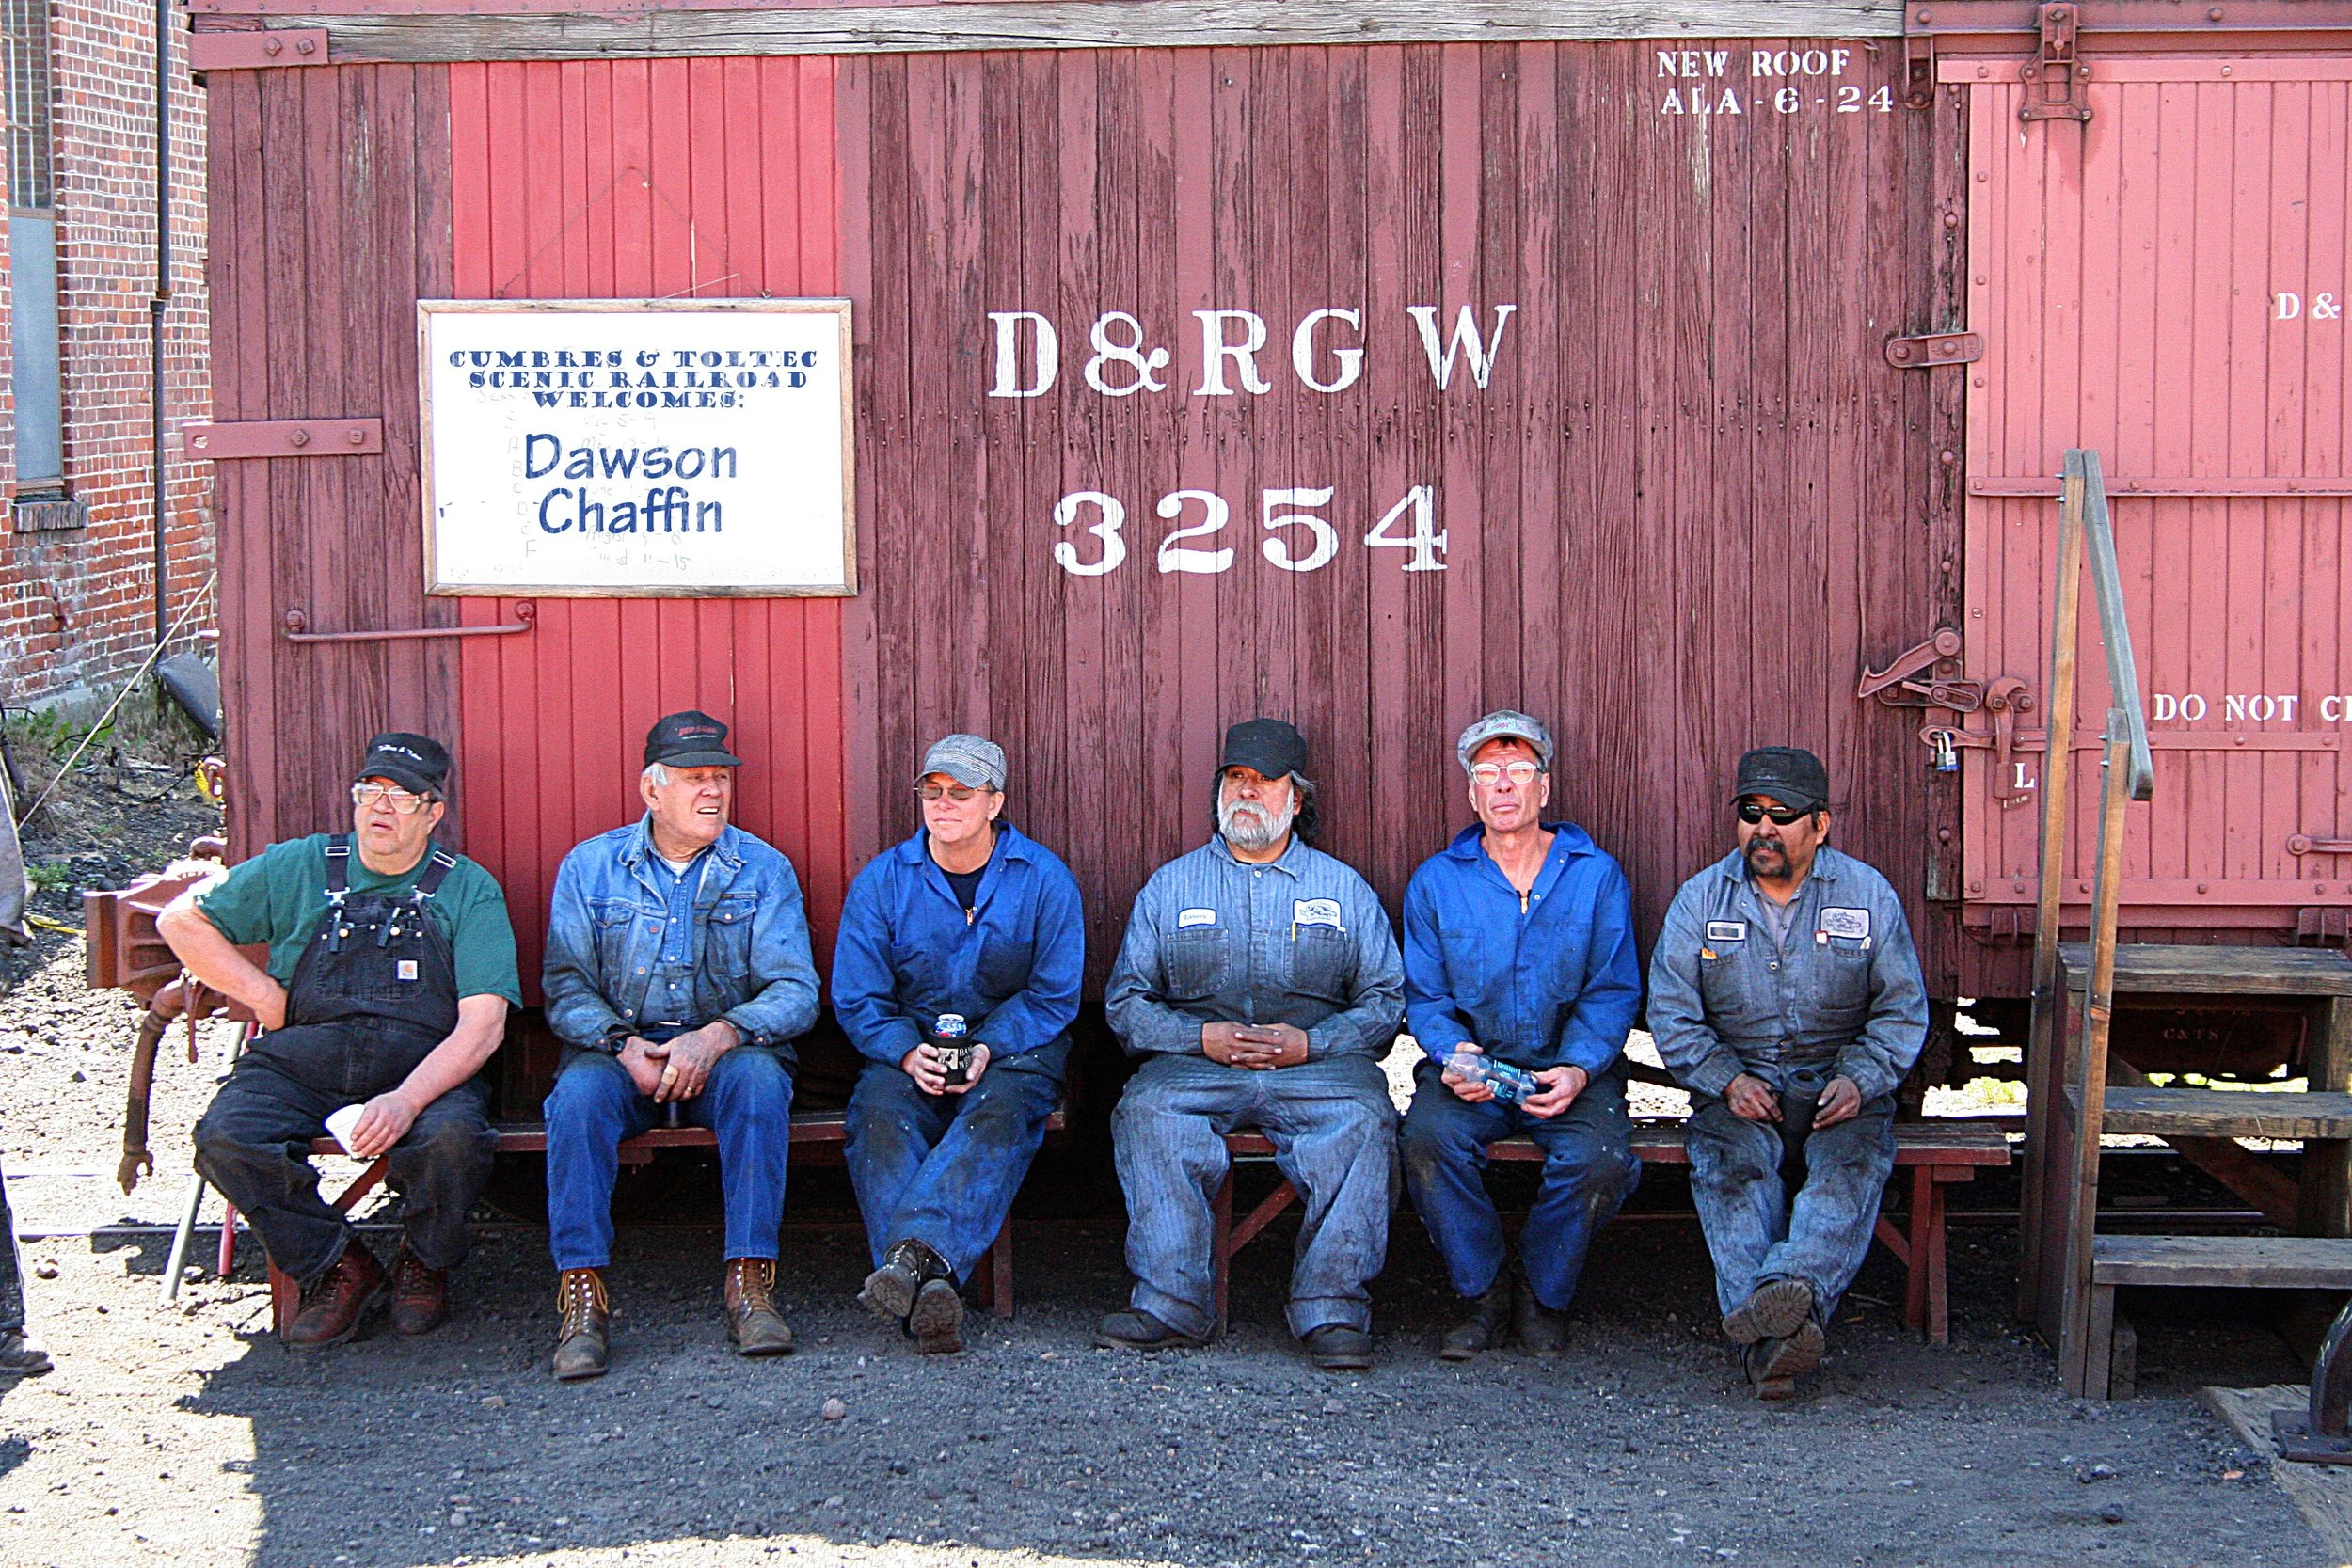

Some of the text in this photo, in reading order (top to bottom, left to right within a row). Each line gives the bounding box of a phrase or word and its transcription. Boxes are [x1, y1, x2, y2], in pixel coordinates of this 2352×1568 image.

[1656, 49, 1851, 78] NEW ROOF
[449, 349, 818, 368] CUMBRES & TOLTEC
[469, 370, 807, 388] SCENIC RAILROAD
[532, 390, 745, 408] WELCOMES:
[525, 433, 737, 480] Dawson
[538, 486, 723, 534] Chaffin
[1053, 484, 1449, 576] 3254
[2153, 693, 2207, 721] DO
[2225, 693, 2299, 721] NOT
[2014, 762, 2035, 788] L
